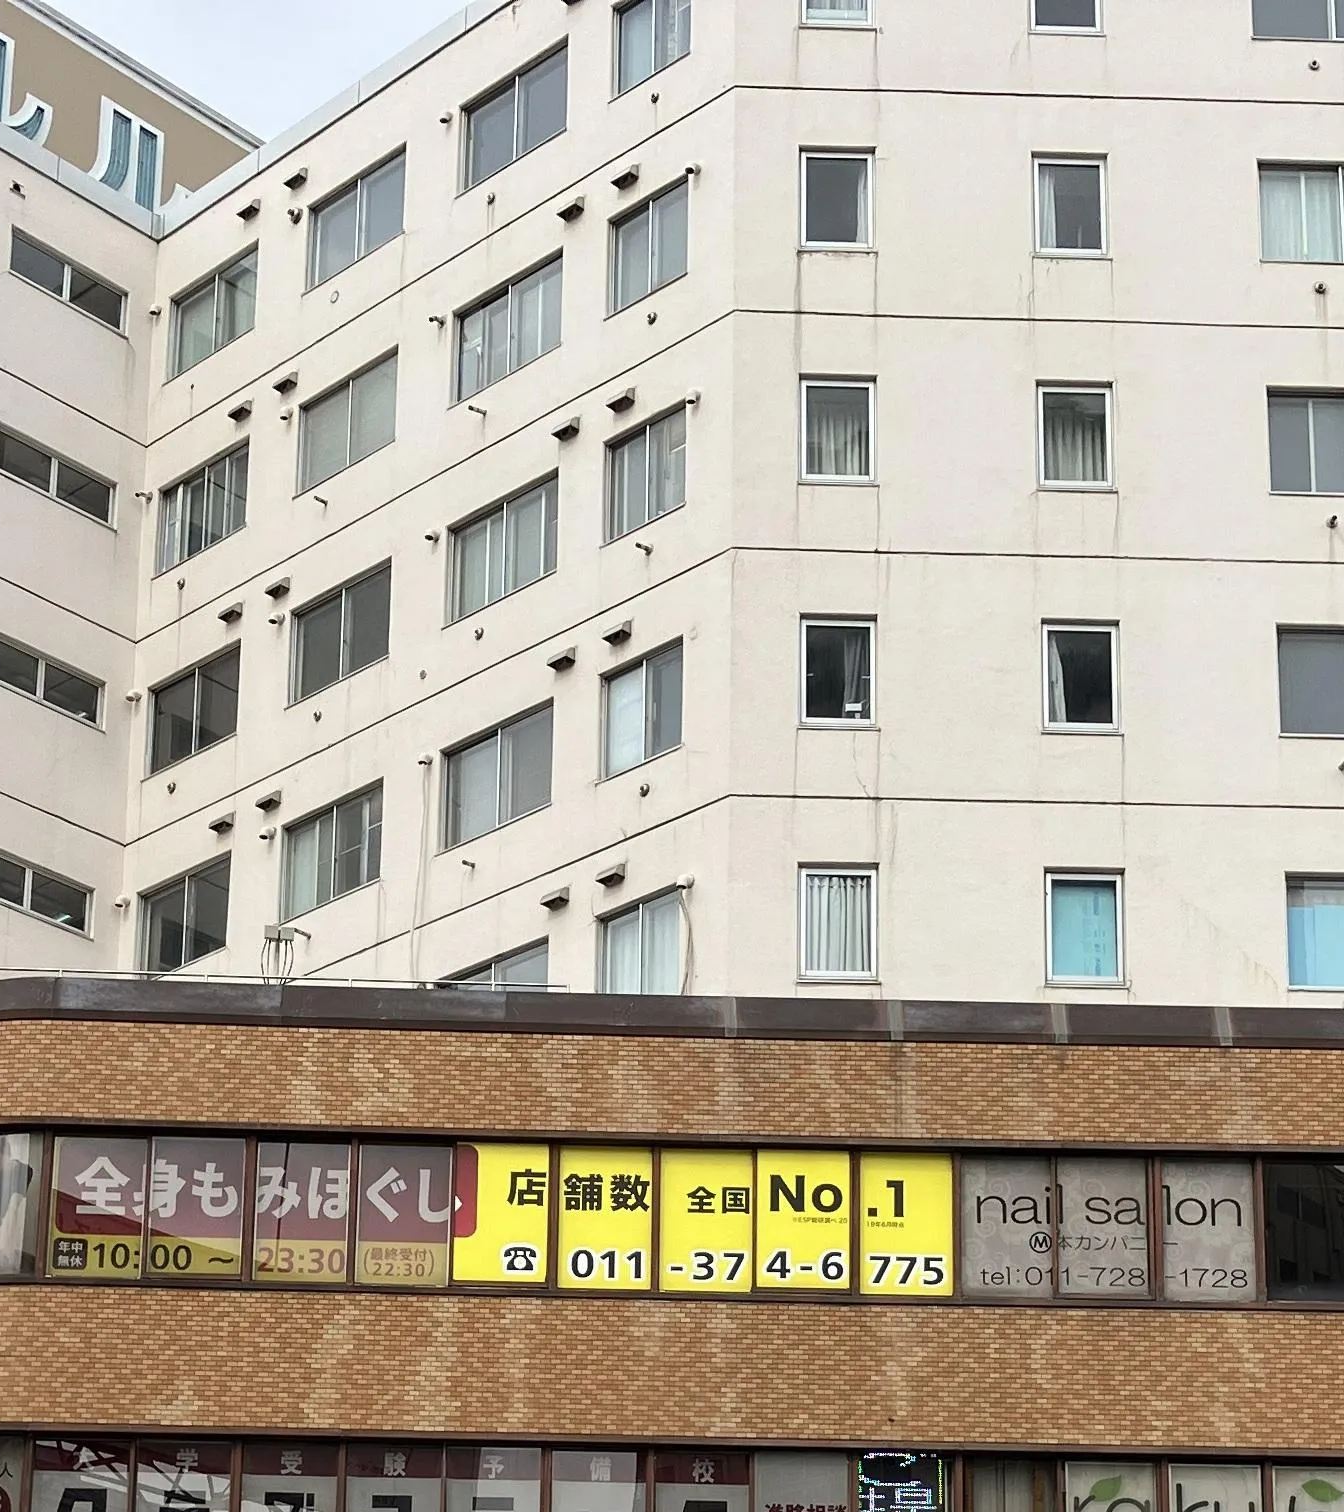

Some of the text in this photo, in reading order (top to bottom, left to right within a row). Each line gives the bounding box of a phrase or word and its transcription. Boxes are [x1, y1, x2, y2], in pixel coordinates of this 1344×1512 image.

[74, 1156, 462, 1224] 全身もみほぐし
[507, 1169, 905, 1218] 店舗数 全国 No.1
[976, 1184, 1243, 1227] nail salon
[258, 1247, 346, 1274] 23:30
